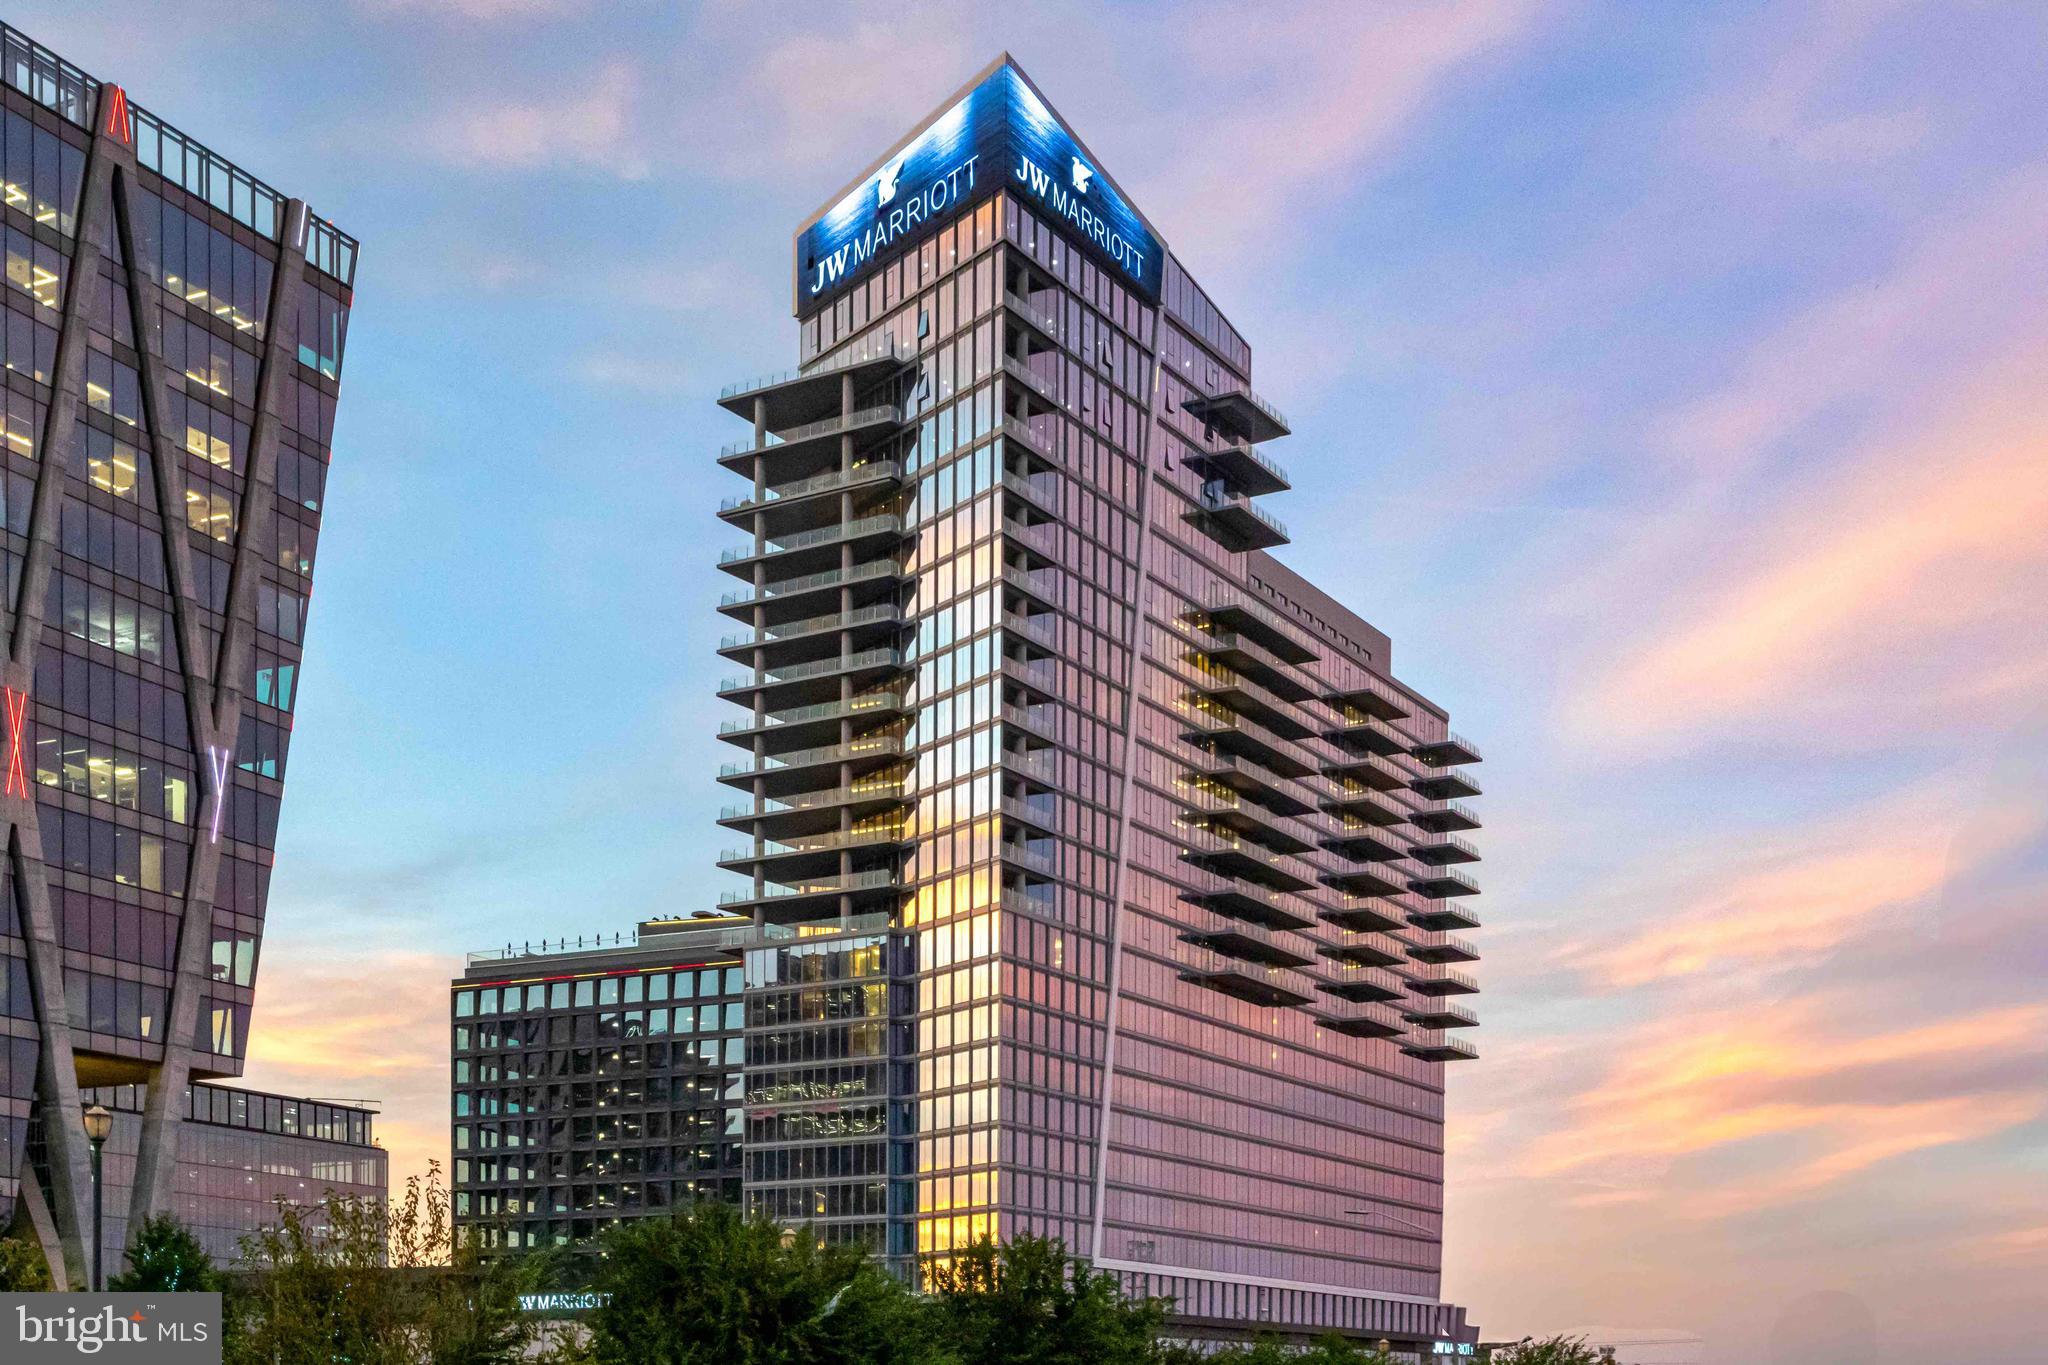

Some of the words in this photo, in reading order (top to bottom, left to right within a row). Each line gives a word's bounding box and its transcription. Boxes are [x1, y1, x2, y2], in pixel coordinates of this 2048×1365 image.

[812, 243, 850, 293] JW
[853, 155, 979, 266] MARRIOTT
[1016, 155, 1050, 198] JW
[1053, 182, 1144, 279] MARRIOTT
[512, 1294, 536, 1310] W
